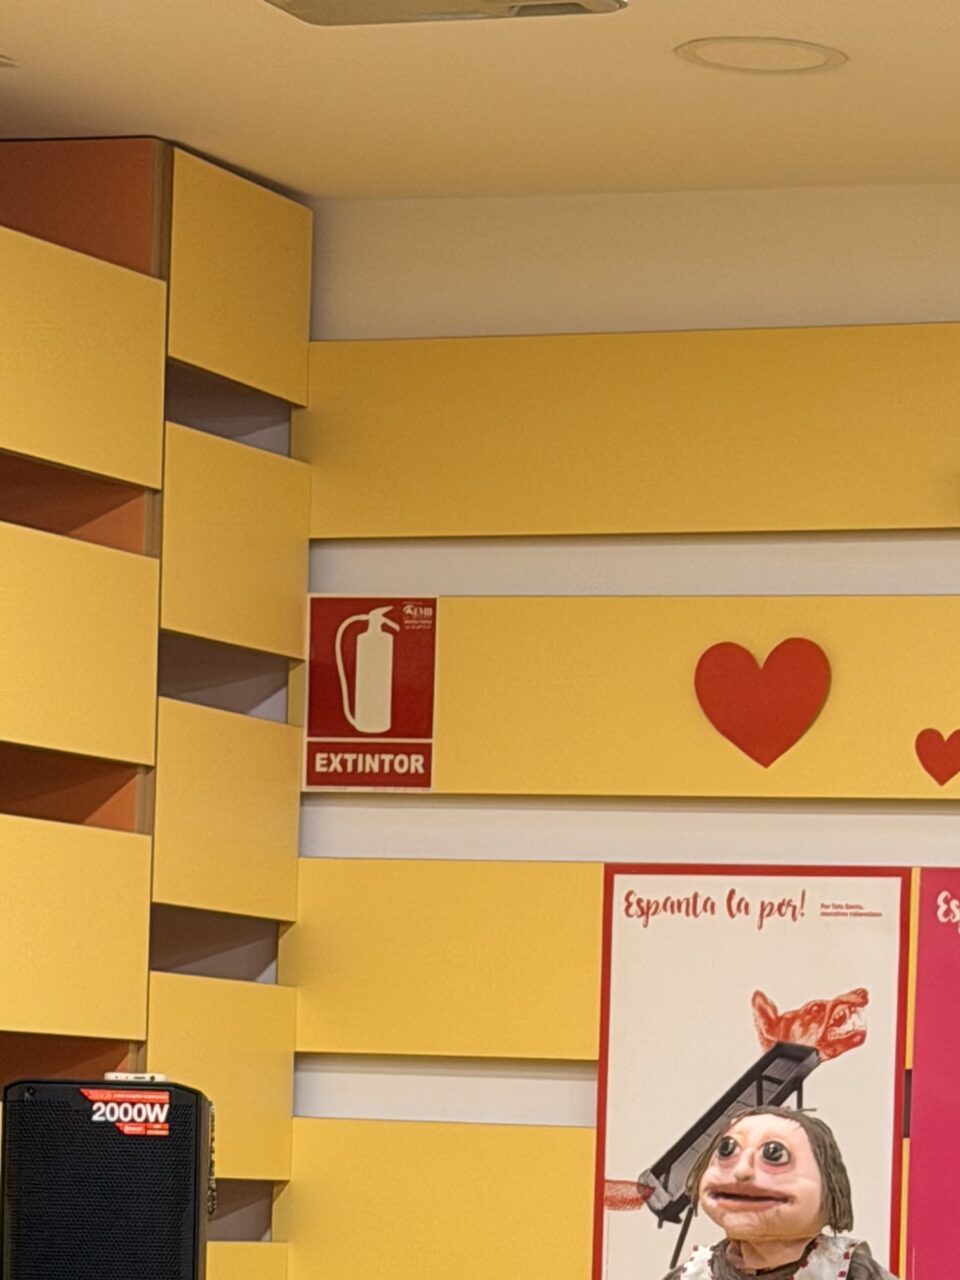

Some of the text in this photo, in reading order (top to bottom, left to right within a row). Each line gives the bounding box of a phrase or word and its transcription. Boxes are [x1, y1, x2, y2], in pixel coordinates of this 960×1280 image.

[314, 752, 425, 775] EXTINTOR
[624, 888, 806, 931] Espanta la por!
[91, 1101, 170, 1123] 2000W
